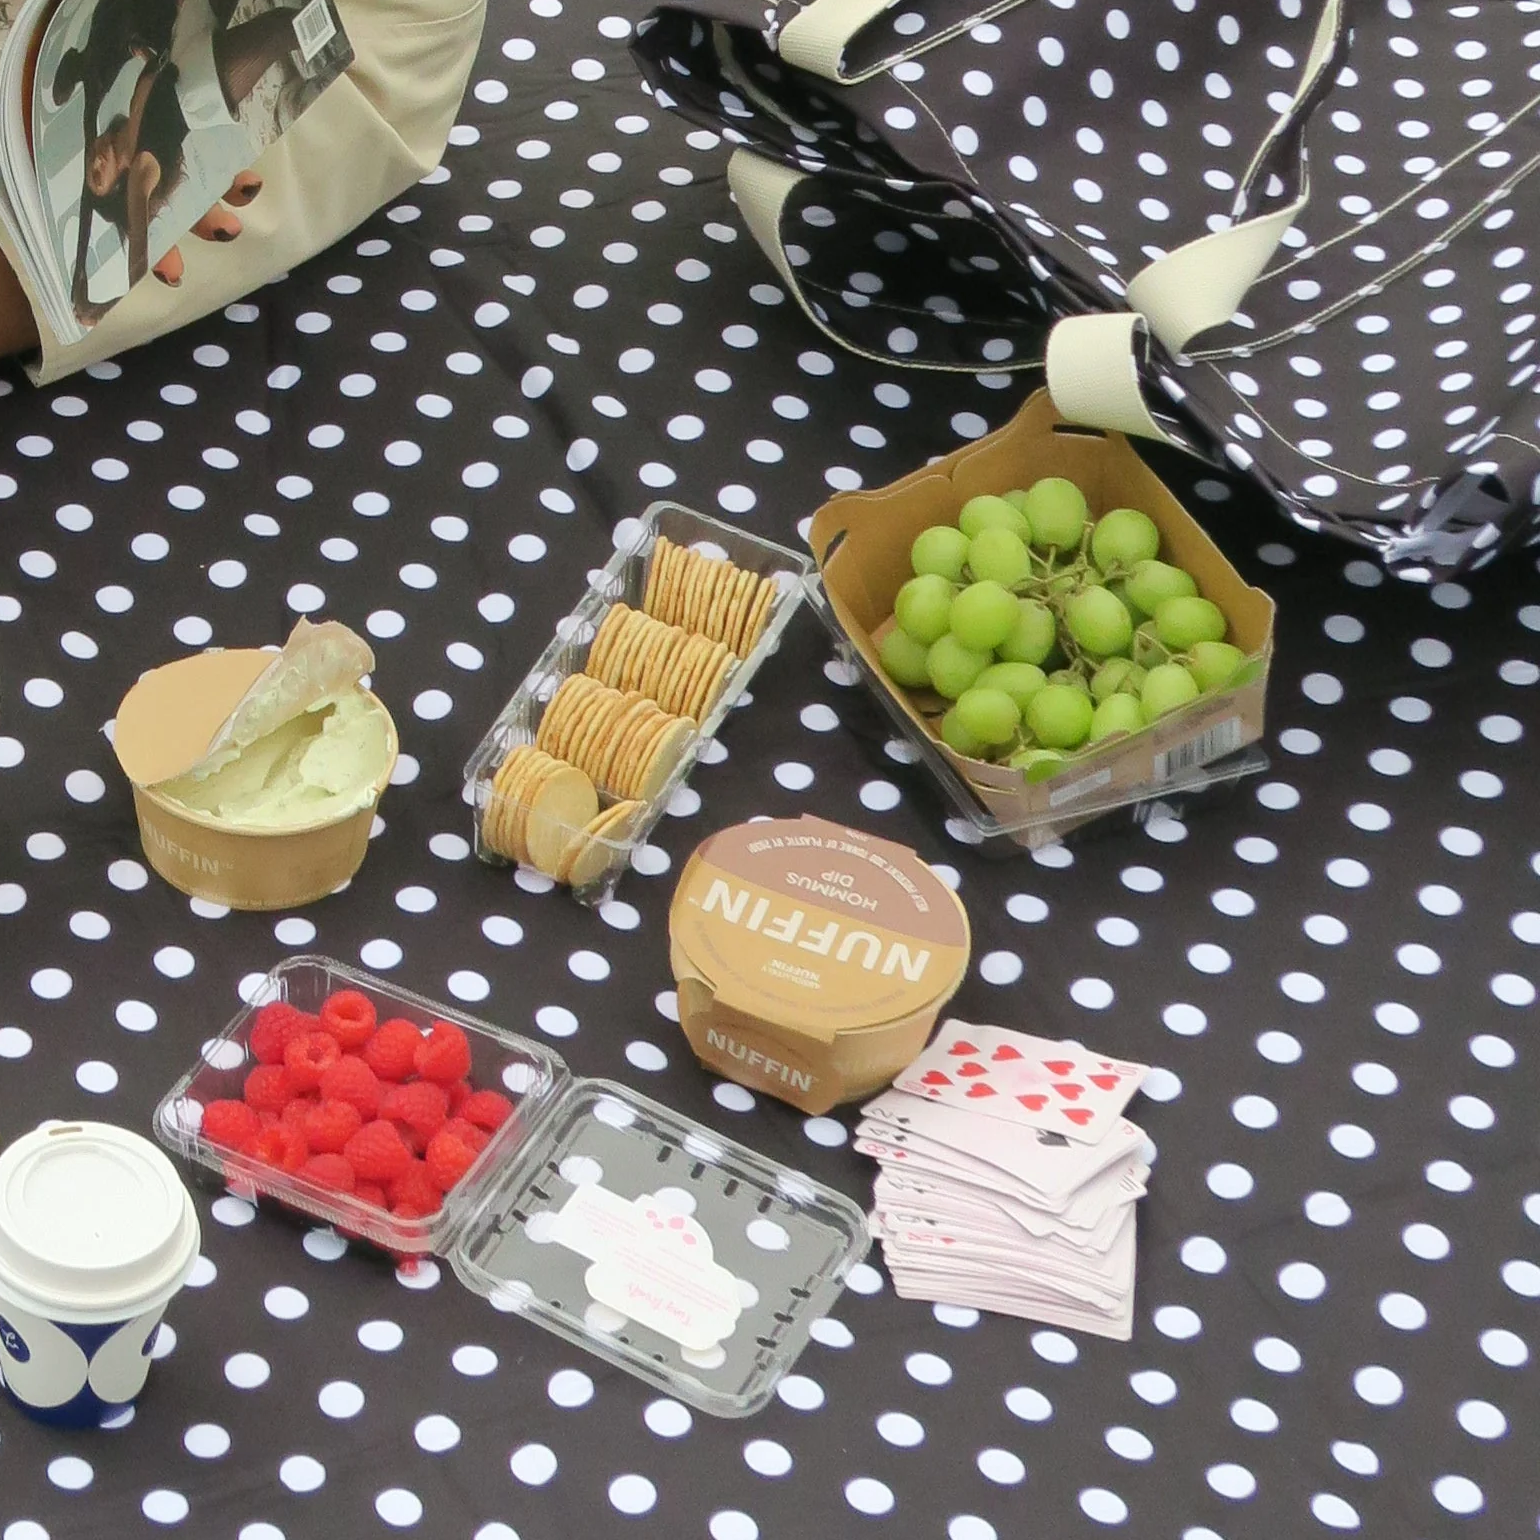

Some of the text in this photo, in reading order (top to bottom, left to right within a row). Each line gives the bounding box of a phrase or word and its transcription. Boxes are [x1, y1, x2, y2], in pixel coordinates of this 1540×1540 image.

[772, 836, 785, 848] BY
[785, 836, 822, 848] PLASTIC
[820, 869, 855, 889] DIP
[784, 871, 879, 912] HOMMUS
[700, 878, 931, 984] NUFFIN
[771, 958, 820, 981] NUFFIN
[706, 1027, 812, 1093] NUFFIN
[864, 1142, 889, 1155] 8
